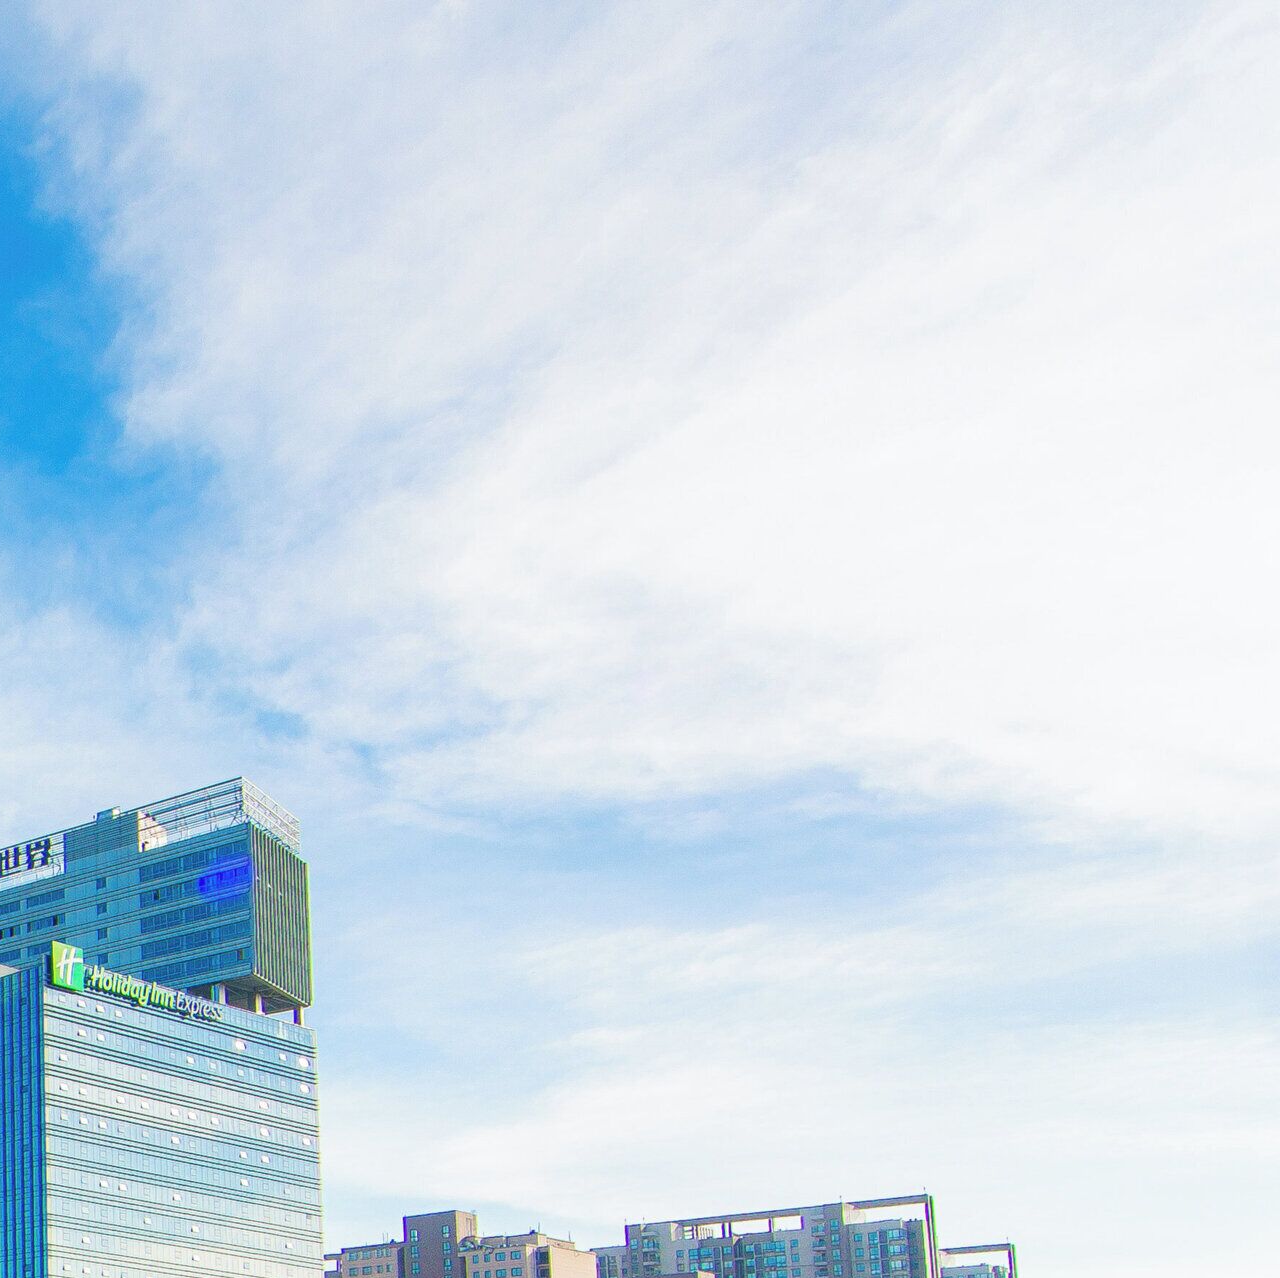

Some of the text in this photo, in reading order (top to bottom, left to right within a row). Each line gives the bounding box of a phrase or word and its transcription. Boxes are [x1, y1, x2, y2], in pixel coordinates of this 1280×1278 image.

[91, 965, 223, 1021] Holiday Inn Express
